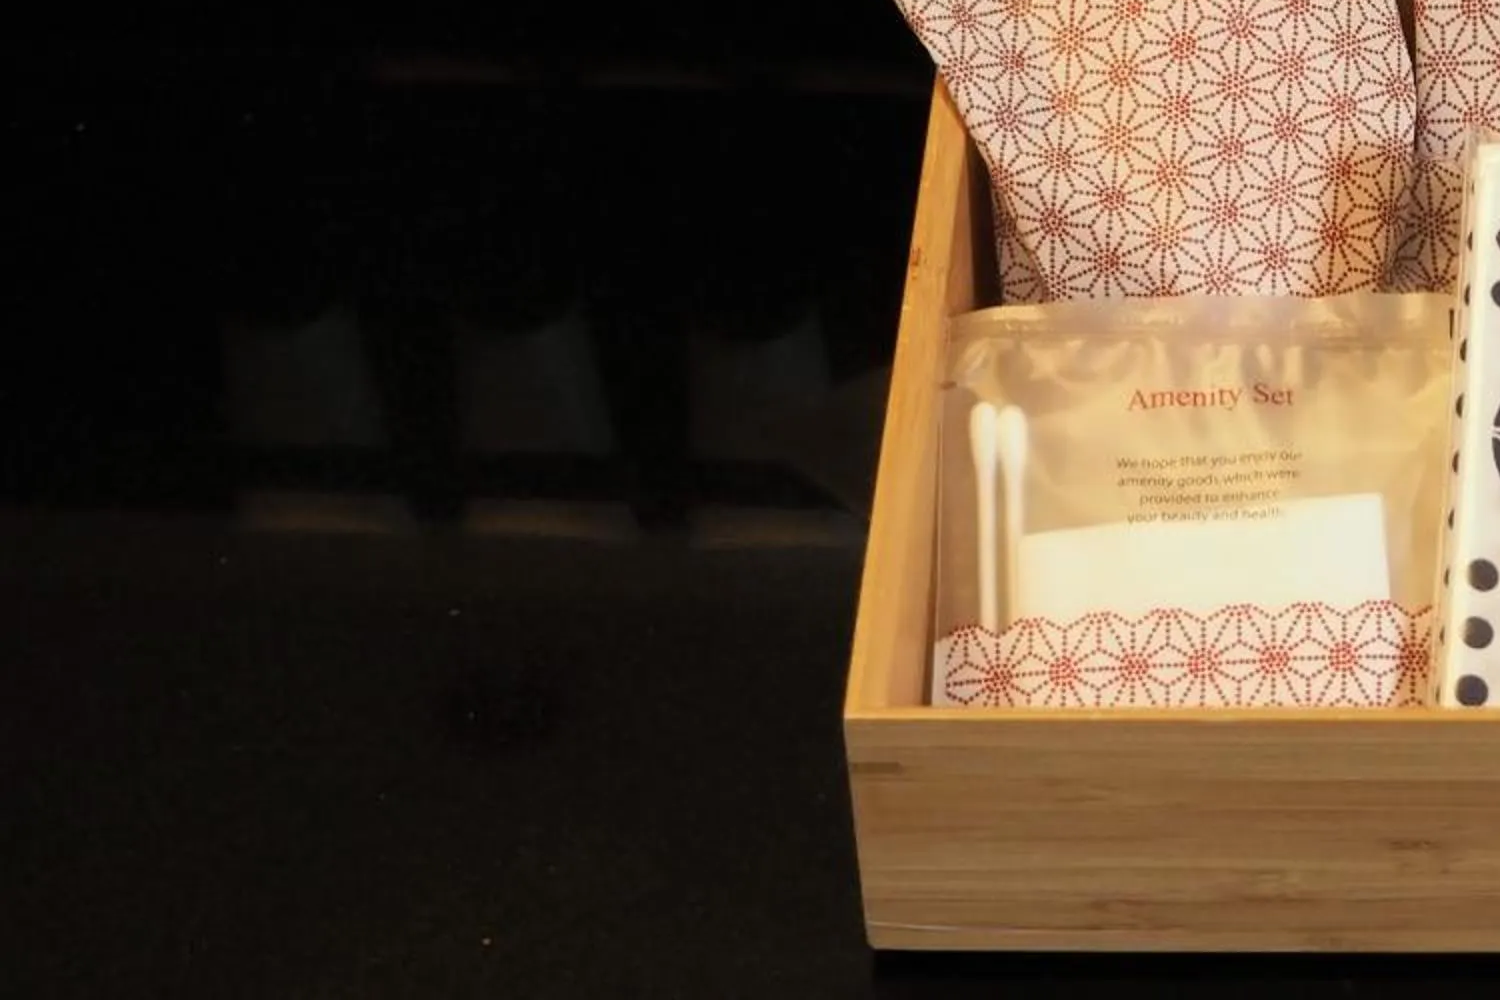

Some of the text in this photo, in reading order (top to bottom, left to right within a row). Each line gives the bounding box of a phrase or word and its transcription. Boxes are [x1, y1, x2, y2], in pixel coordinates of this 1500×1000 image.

[1128, 382, 1294, 411] Amenity Set
[1117, 457, 1138, 469] We
[1141, 457, 1177, 471] hope
[1181, 454, 1209, 466] that
[1211, 455, 1237, 470] you
[1139, 492, 1201, 506] provided
[1204, 493, 1219, 503] to
[1127, 511, 1157, 525] your
[1211, 508, 1238, 520] and
